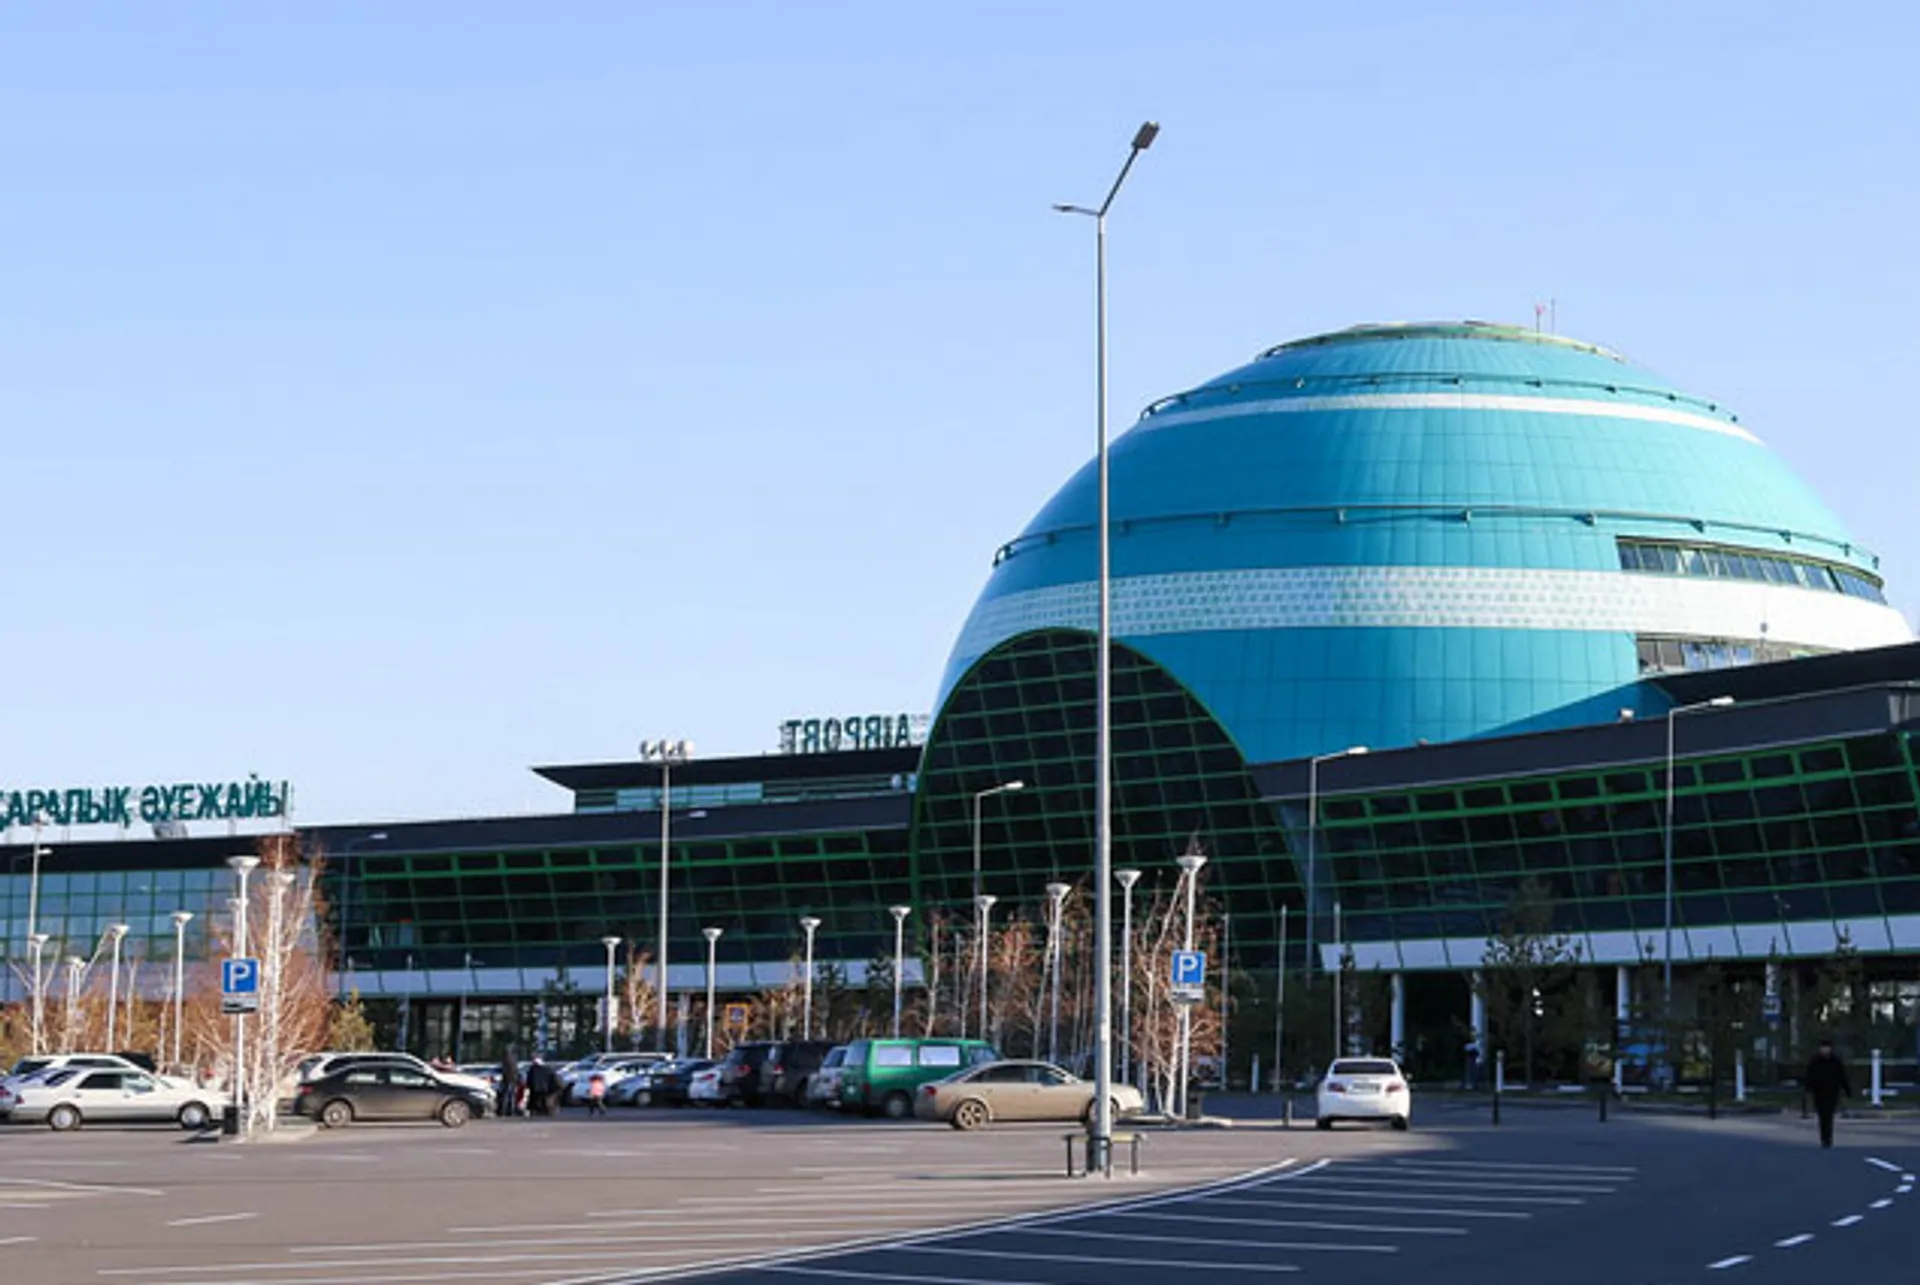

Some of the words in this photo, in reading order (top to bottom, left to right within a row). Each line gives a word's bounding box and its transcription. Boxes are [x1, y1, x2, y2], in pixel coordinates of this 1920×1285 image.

[0, 786, 131, 831] АРАЛЫҚ
[229, 962, 252, 992] P
[1178, 954, 1199, 982] P
